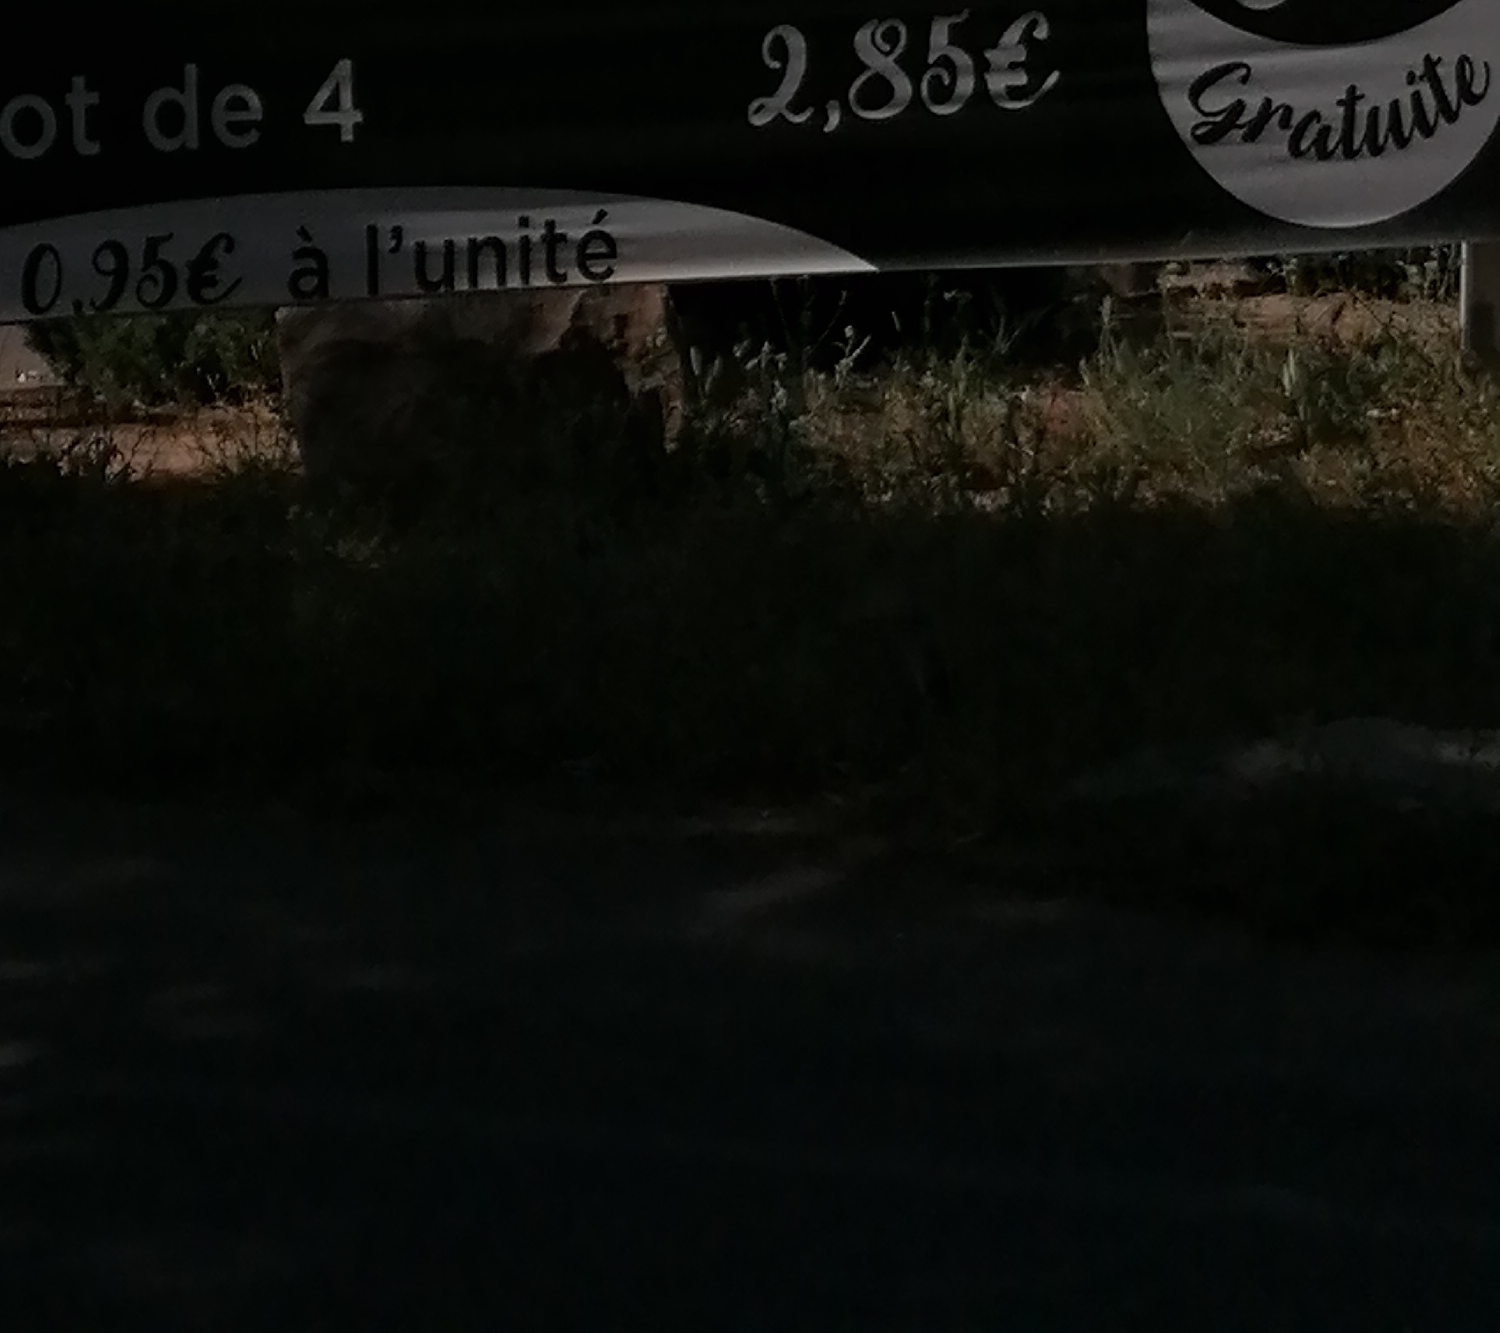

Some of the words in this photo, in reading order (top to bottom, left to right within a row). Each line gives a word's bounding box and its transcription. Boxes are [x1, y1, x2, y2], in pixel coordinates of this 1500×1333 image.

[140, 61, 265, 153] de
[302, 56, 366, 144] 4
[746, 6, 1063, 134] 2,85€
[1187, 53, 1491, 162] Gratuite
[287, 225, 331, 301] à
[365, 208, 620, 297] l'unité
